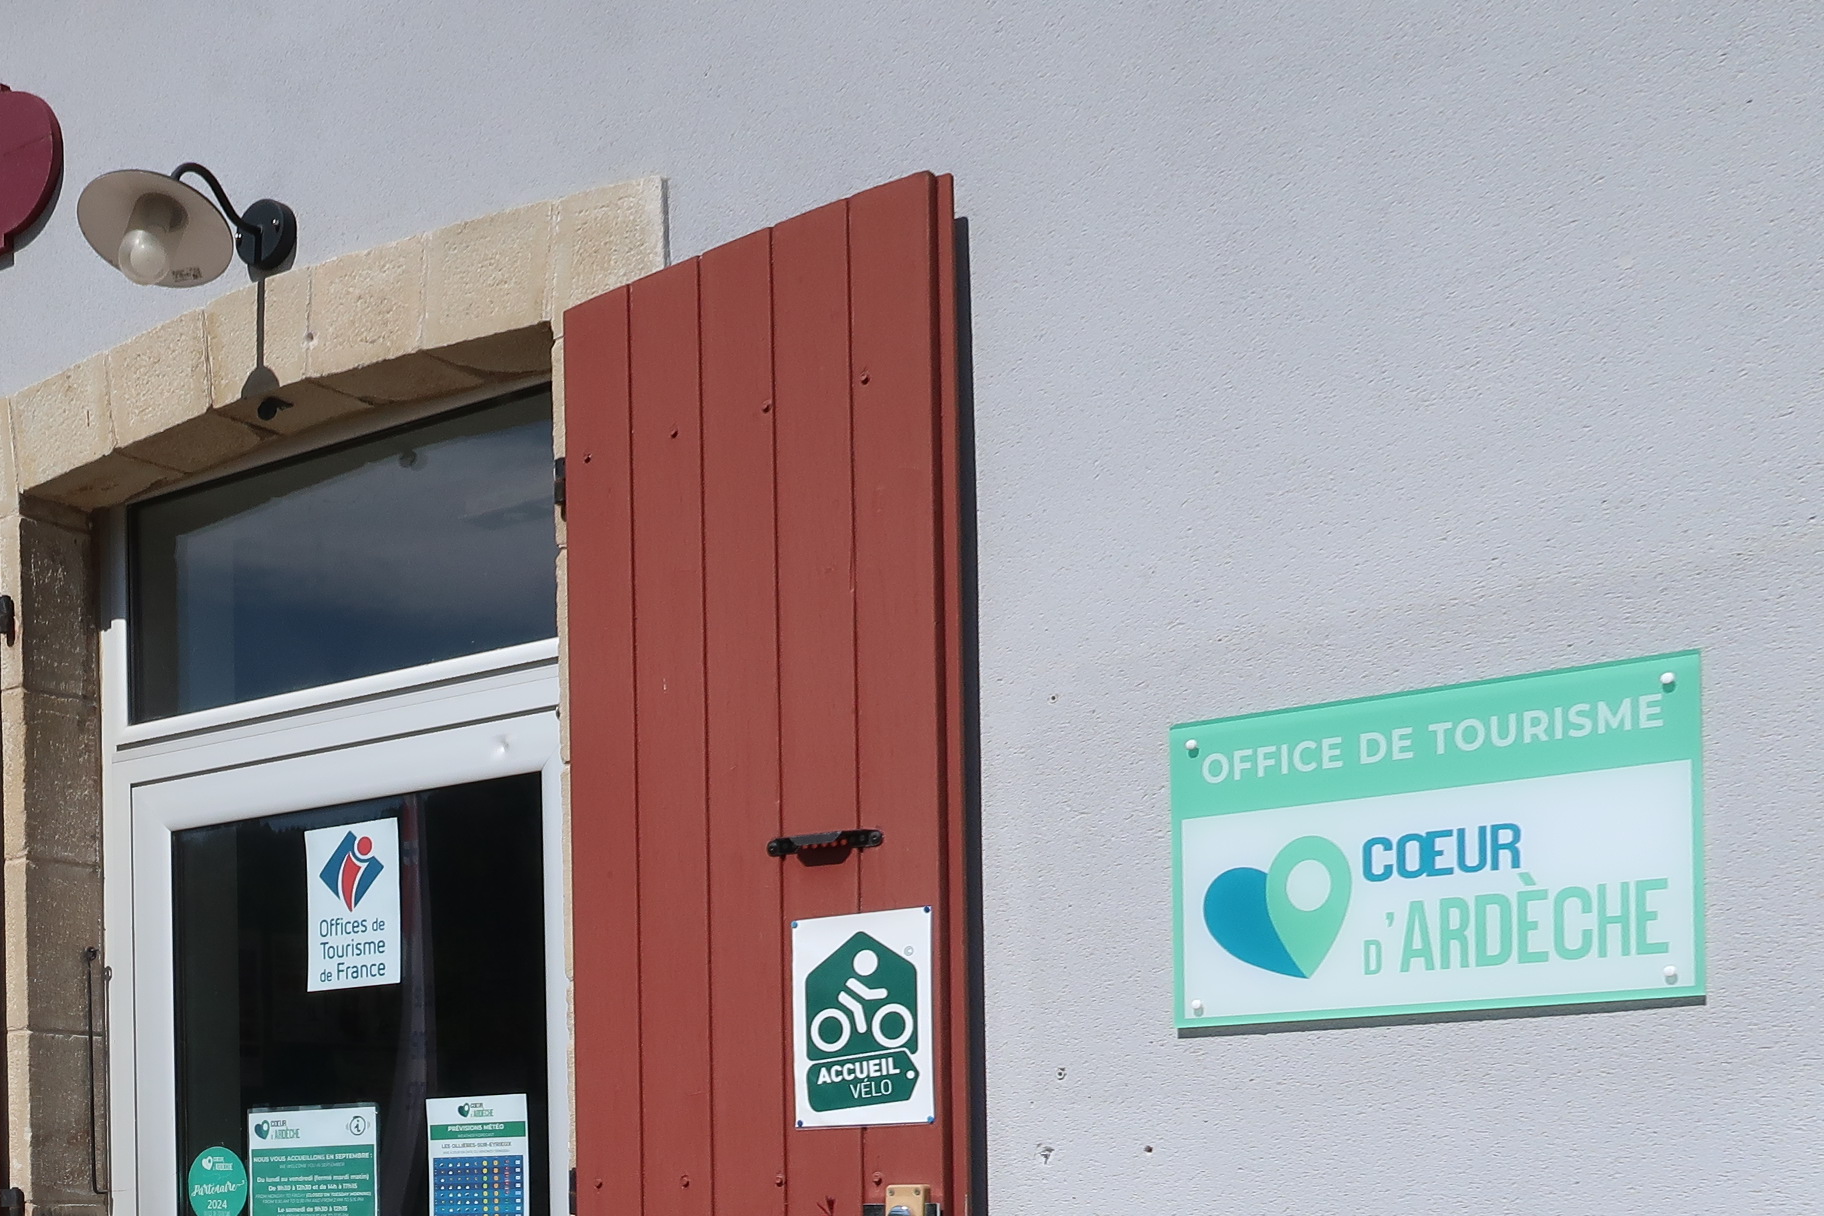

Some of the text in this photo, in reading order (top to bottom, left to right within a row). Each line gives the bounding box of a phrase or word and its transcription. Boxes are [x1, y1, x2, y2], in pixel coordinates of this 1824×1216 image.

[1201, 693, 1665, 784] OFFICE DE TOURISME
[319, 918, 385, 937] Offices de
[320, 939, 385, 960] Tourisme
[320, 962, 386, 983] de France
[817, 1057, 900, 1085] ACCUEIL
[849, 1079, 893, 1099] VÉLO
[191, 1180, 245, 1197] Partenaire
[207, 1200, 227, 1209] 2024
